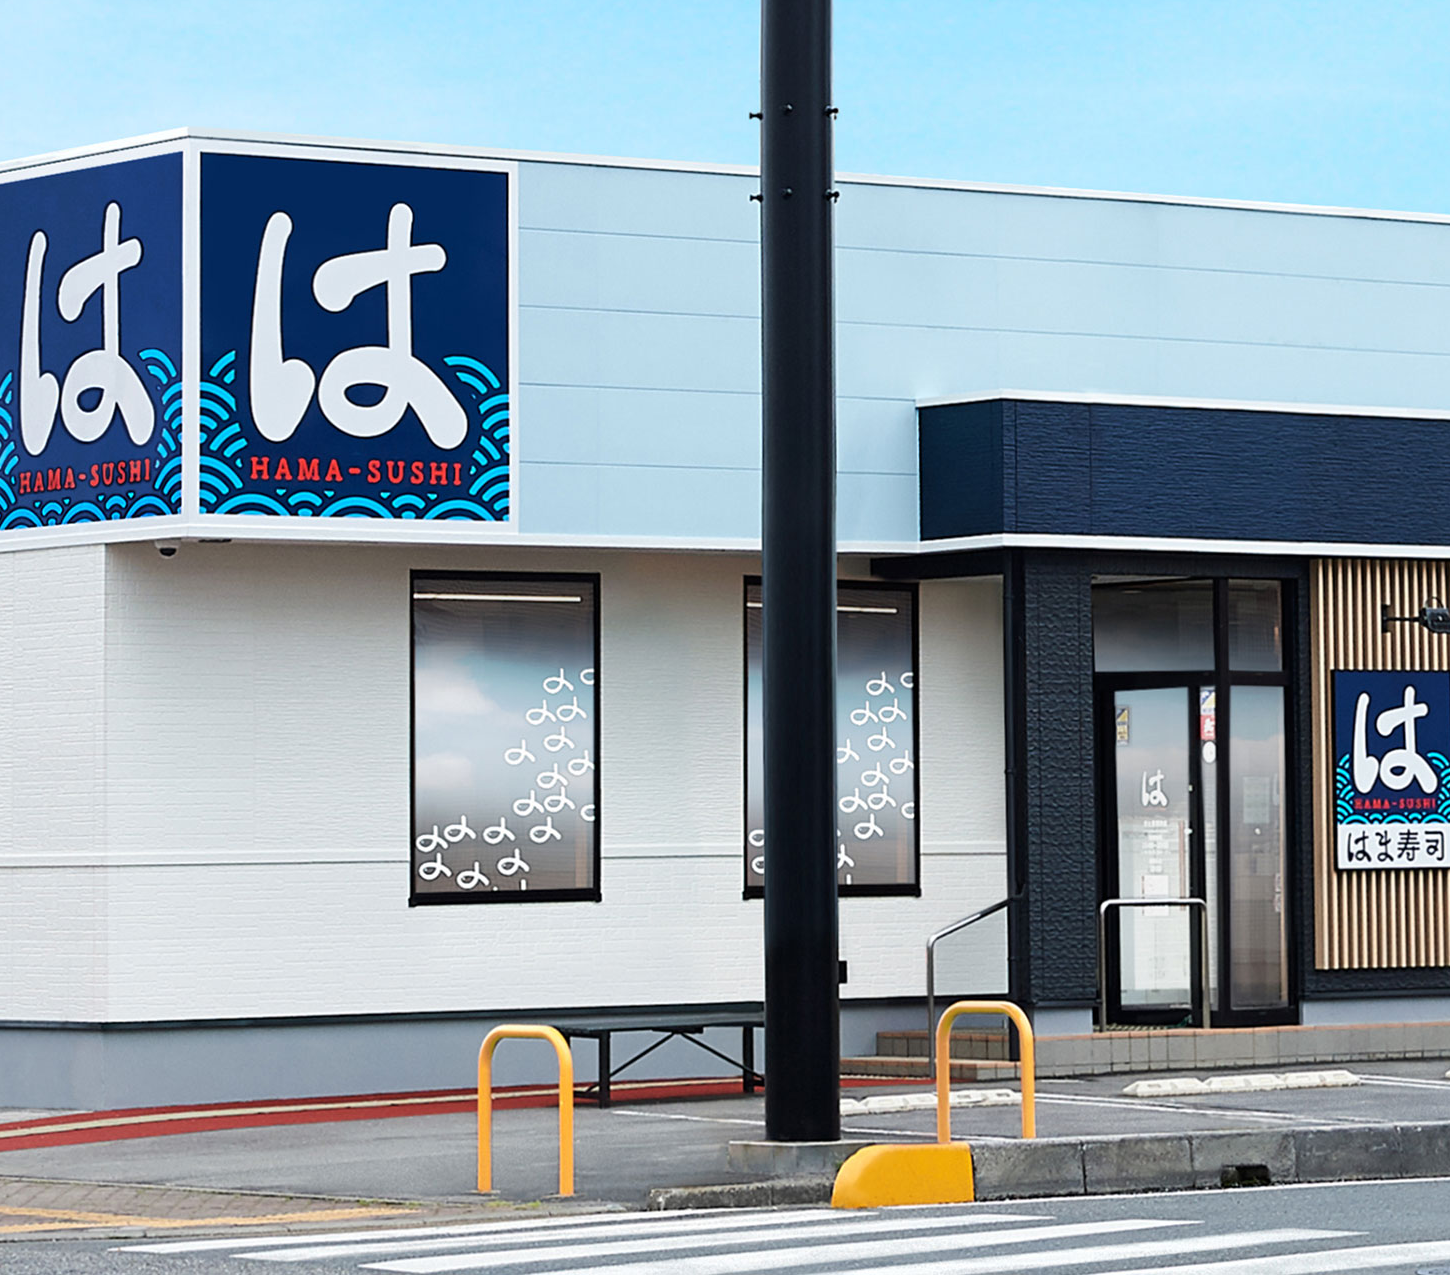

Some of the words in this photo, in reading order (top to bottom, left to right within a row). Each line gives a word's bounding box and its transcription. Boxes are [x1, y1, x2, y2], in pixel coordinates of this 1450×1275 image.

[20, 202, 155, 456] は
[250, 203, 468, 450] は
[18, 459, 150, 494] HAMA-SUSHI
[249, 456, 463, 486] HAMA-SUSHI
[1353, 686, 1438, 794] は
[1142, 769, 1168, 806] は
[1348, 829, 1445, 863] はま寿司
